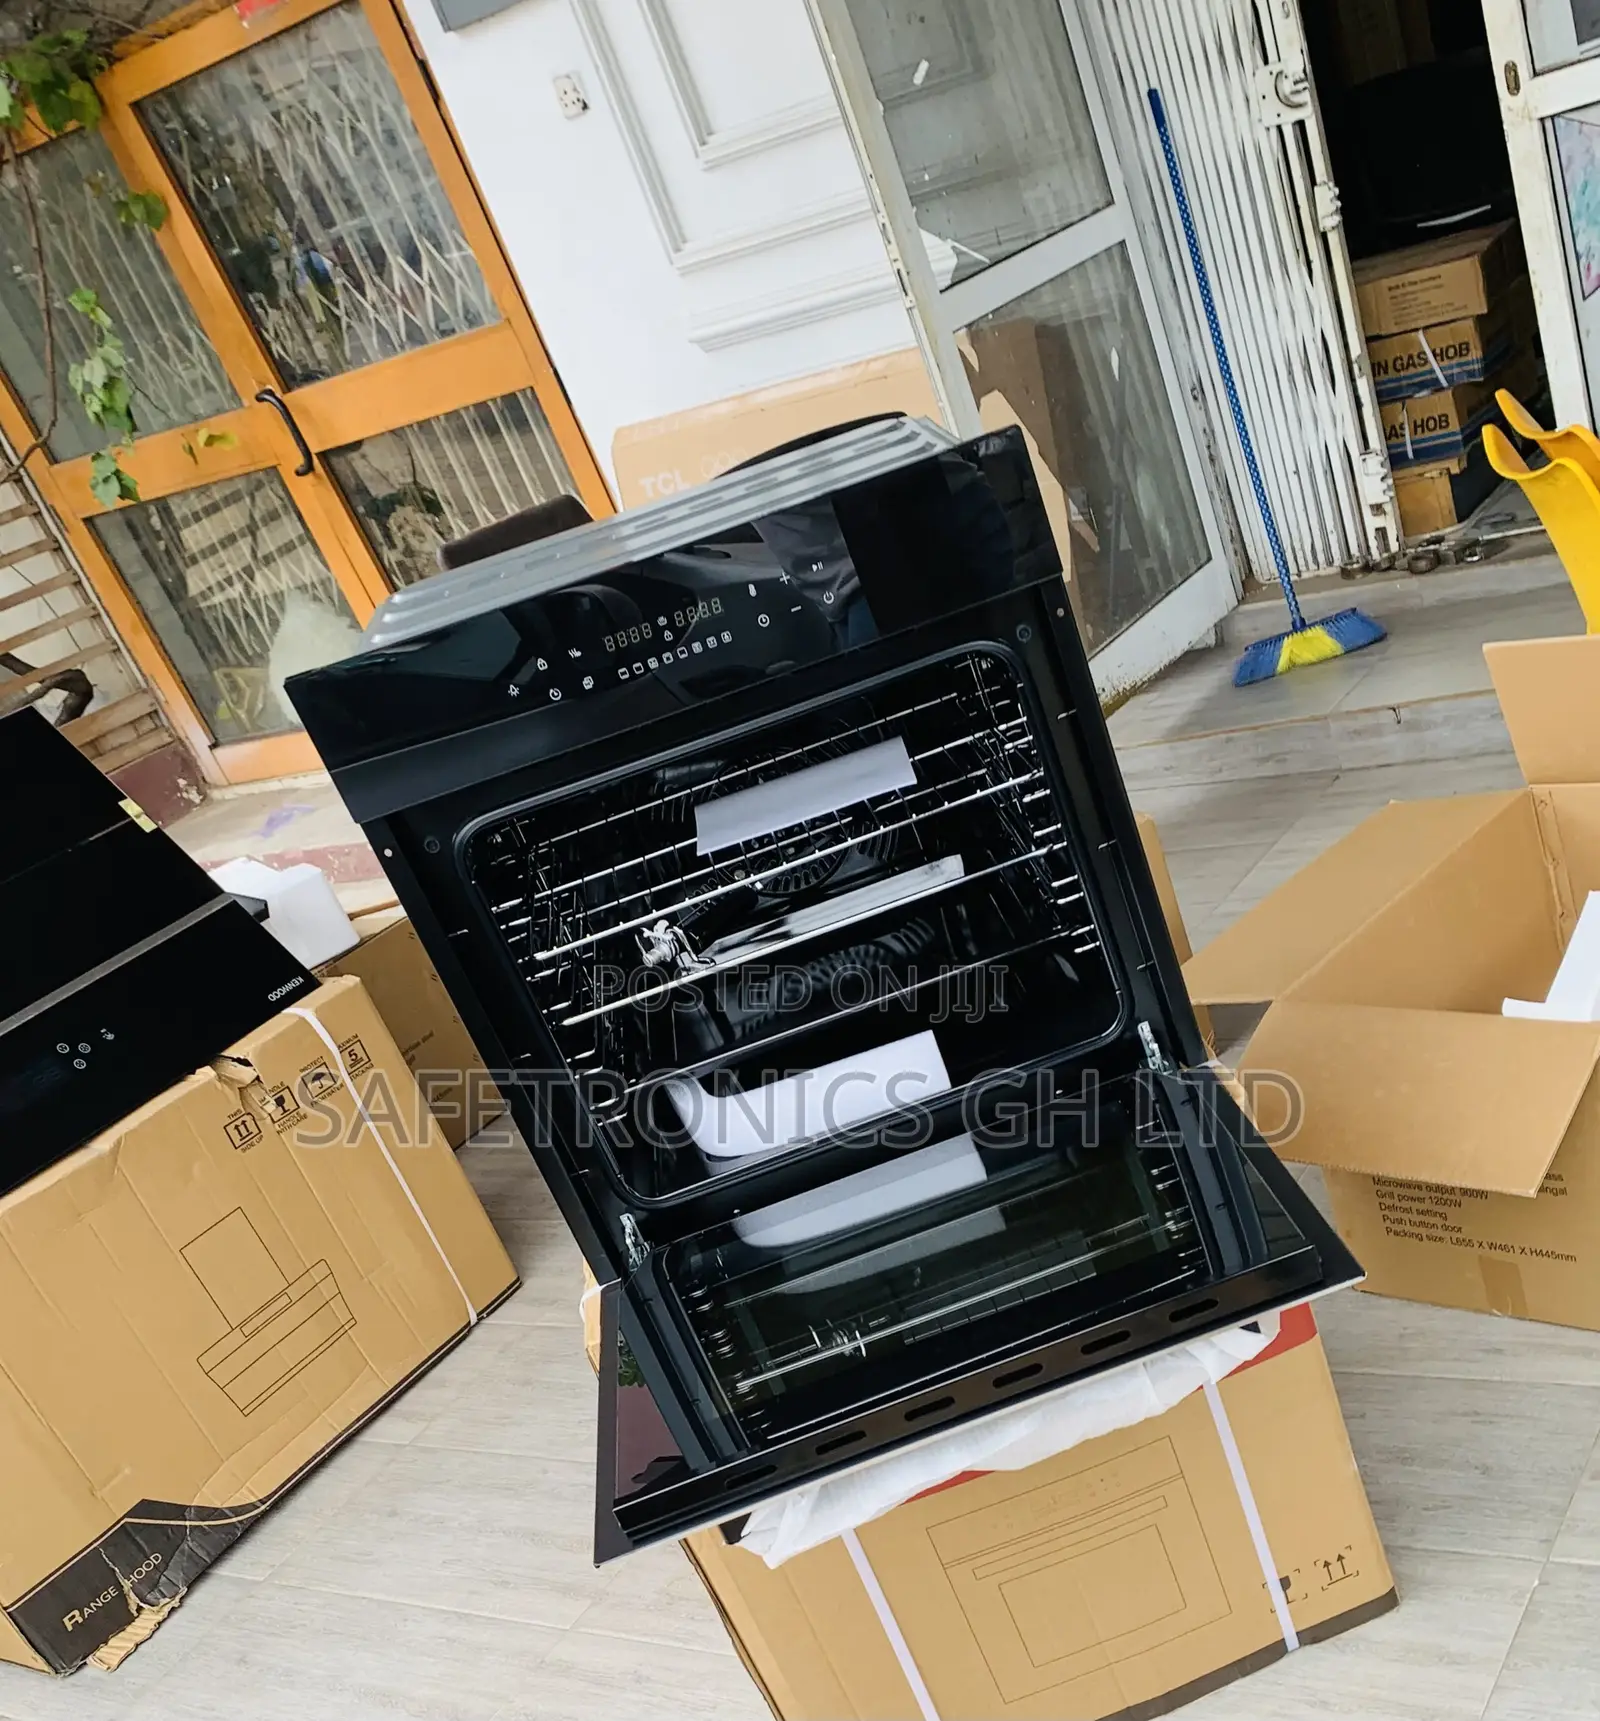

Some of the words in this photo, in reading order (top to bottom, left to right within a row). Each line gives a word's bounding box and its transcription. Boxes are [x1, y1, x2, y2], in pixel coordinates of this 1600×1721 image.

[1393, 351, 1428, 373] GAS
[1432, 342, 1470, 362] HOB
[1384, 421, 1406, 440] AS
[1413, 413, 1450, 435] HOB
[639, 470, 691, 498] TCL
[267, 976, 304, 1002] KENWOOD
[337, 1033, 359, 1050] AXIMUM
[299, 1055, 325, 1073] PROTECT
[348, 1048, 359, 1062] 5
[227, 1108, 243, 1121] THIS
[277, 1111, 300, 1128] HANDLE
[291, 1112, 308, 1127] CARE
[240, 1140, 256, 1154] SIDE
[254, 1134, 264, 1145] UP
[1372, 1177, 1423, 1191] Microwave
[1425, 1183, 1457, 1197] output
[1459, 1187, 1489, 1200] 900W
[1376, 1189, 1395, 1201] Grill
[1397, 1193, 1426, 1206] power
[1428, 1195, 1462, 1209] 1200W
[1378, 1202, 1414, 1216] Defrost
[1416, 1208, 1448, 1221] setting
[1382, 1214, 1407, 1227] Push
[1408, 1218, 1439, 1231] button
[1441, 1222, 1463, 1234] door
[1385, 1226, 1424, 1242] Packing
[1425, 1231, 1448, 1244] size:
[1450, 1236, 1475, 1249] L655
[1487, 1241, 1516, 1255] W461
[1529, 1247, 1577, 1263] H445mm
[62, 1586, 118, 1632] RANGE
[126, 1552, 163, 1588] HOOD
